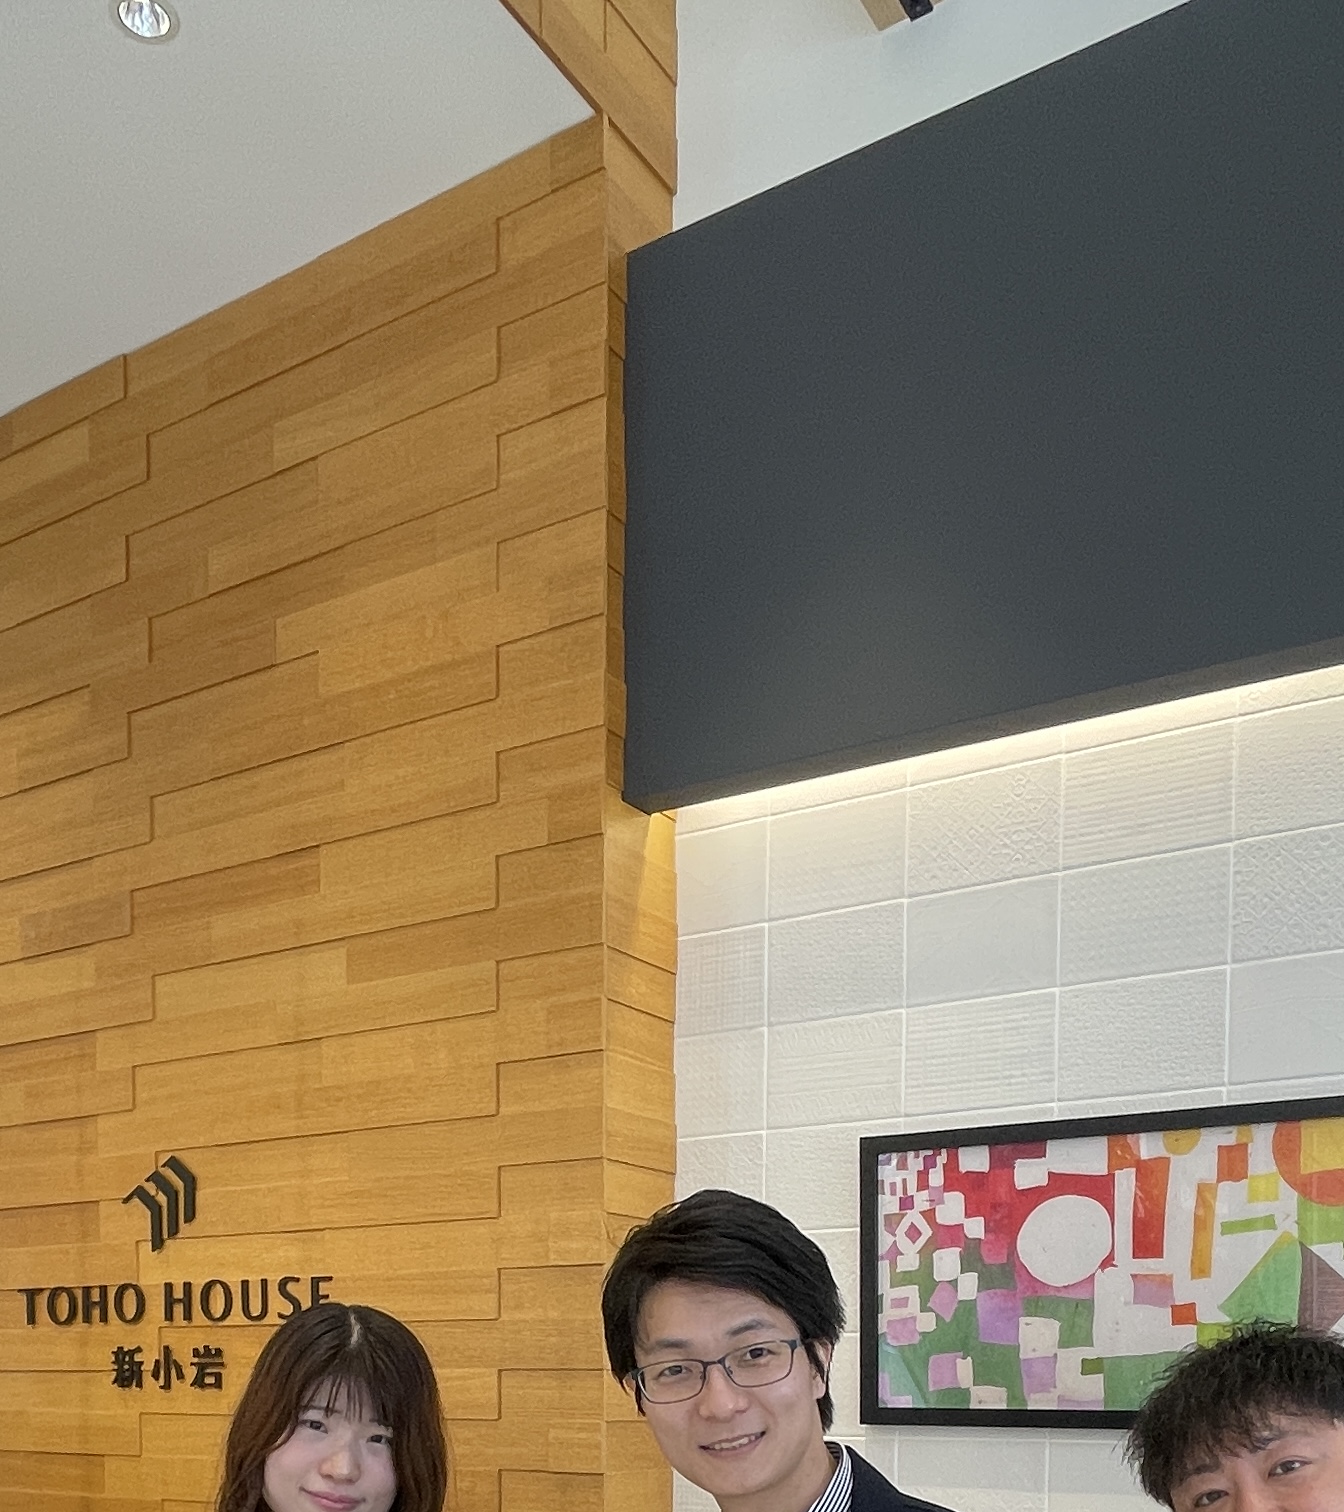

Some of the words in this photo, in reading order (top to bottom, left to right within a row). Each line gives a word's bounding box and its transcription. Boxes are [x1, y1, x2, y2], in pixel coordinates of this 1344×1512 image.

[18, 1283, 146, 1326] TOHO
[163, 1275, 335, 1323] HOUSE
[111, 1345, 226, 1390] 新小岩
